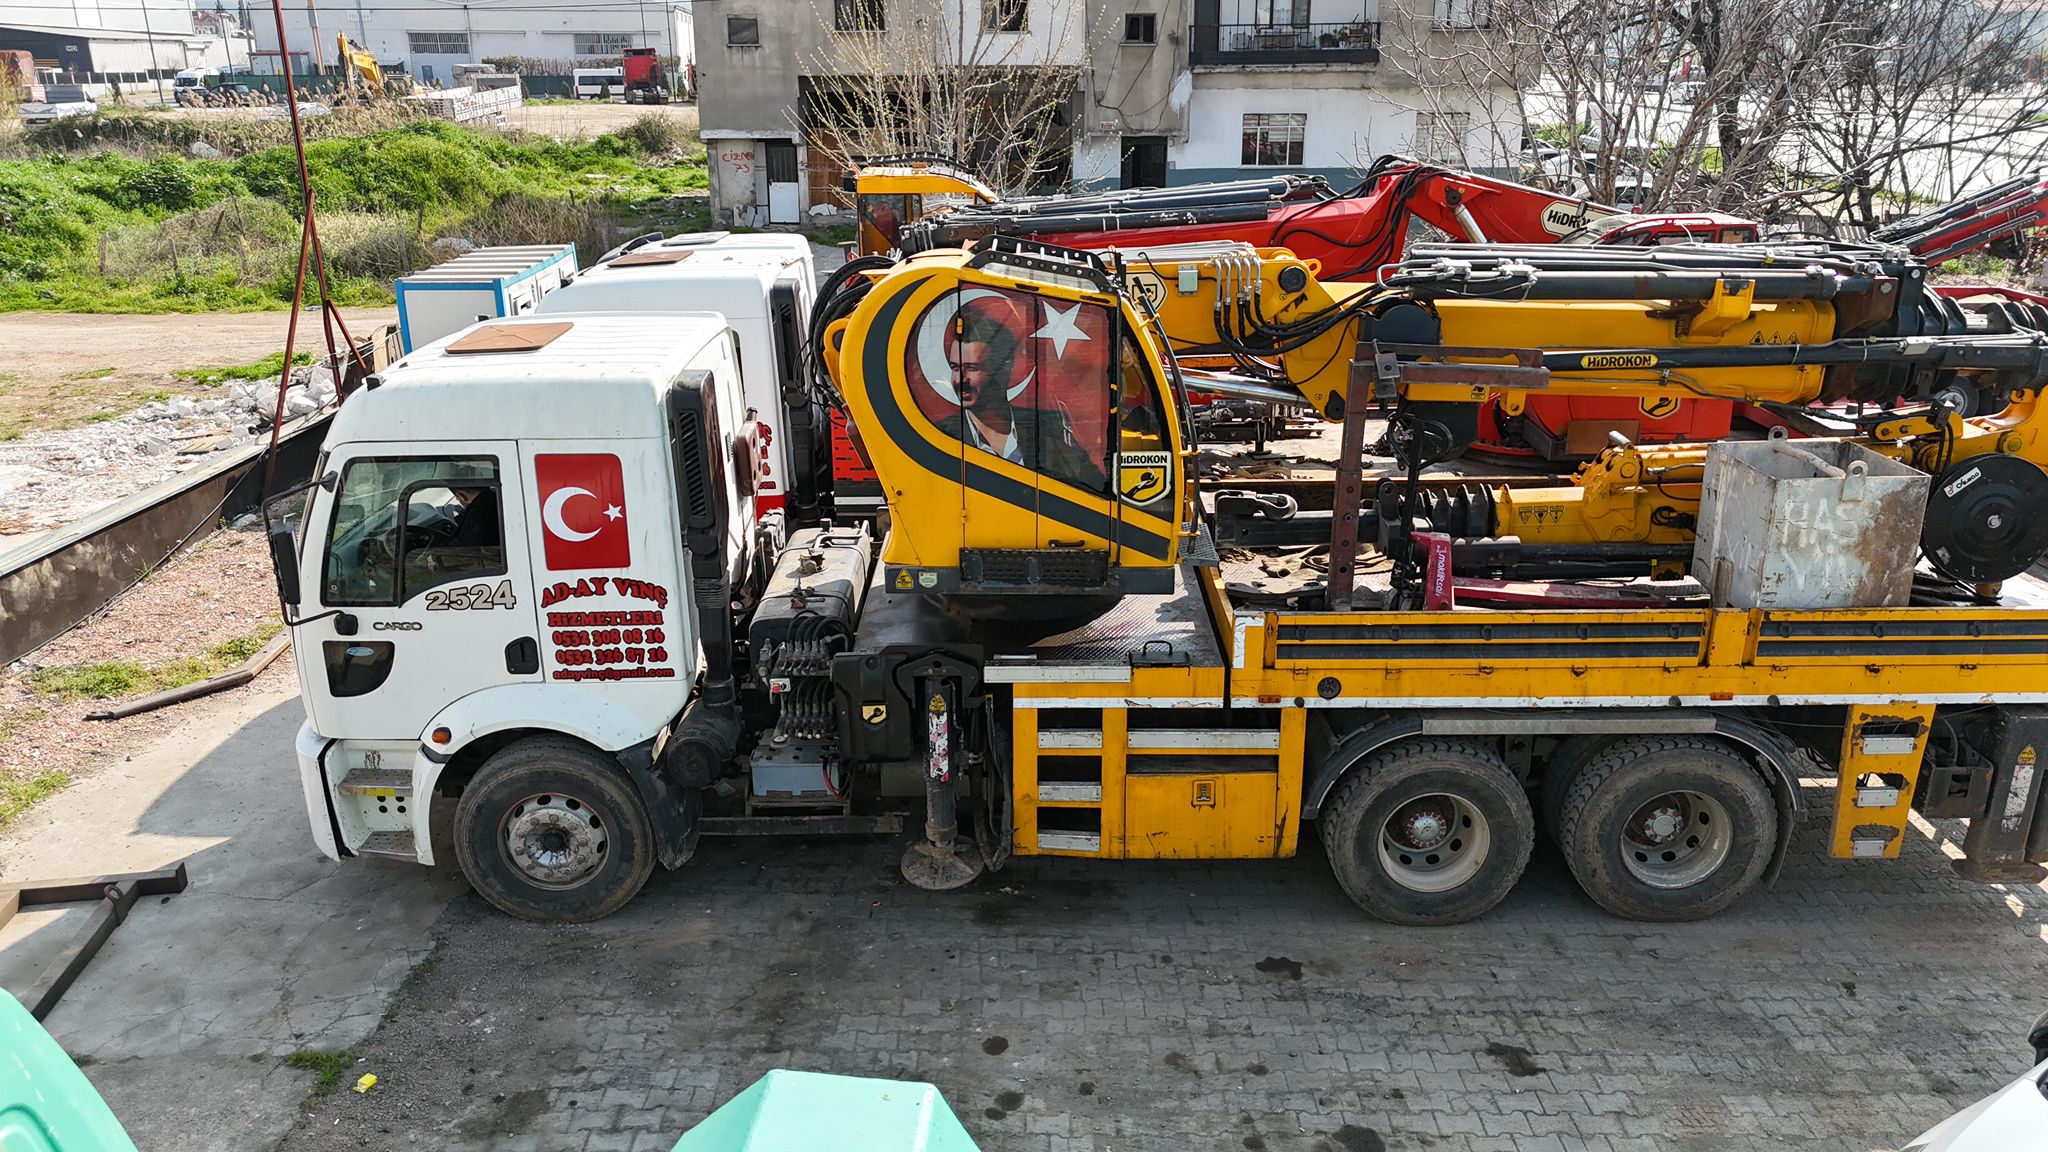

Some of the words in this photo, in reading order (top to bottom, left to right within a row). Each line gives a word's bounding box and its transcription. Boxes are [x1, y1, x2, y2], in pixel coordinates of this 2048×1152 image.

[1587, 355, 1652, 367] HiDROKON
[425, 580, 517, 610] 2524
[541, 577, 609, 608] AD-AY
[373, 622, 423, 631] CARGO
[547, 611, 664, 627] HiZMETLERi
[552, 630, 591, 647] 0532
[591, 629, 621, 647] 308
[622, 628, 643, 644] 08
[645, 627, 665, 644] 16
[555, 649, 594, 666] 0532
[594, 647, 624, 665] 326
[625, 647, 645, 665] 87
[647, 646, 668, 662] 16
